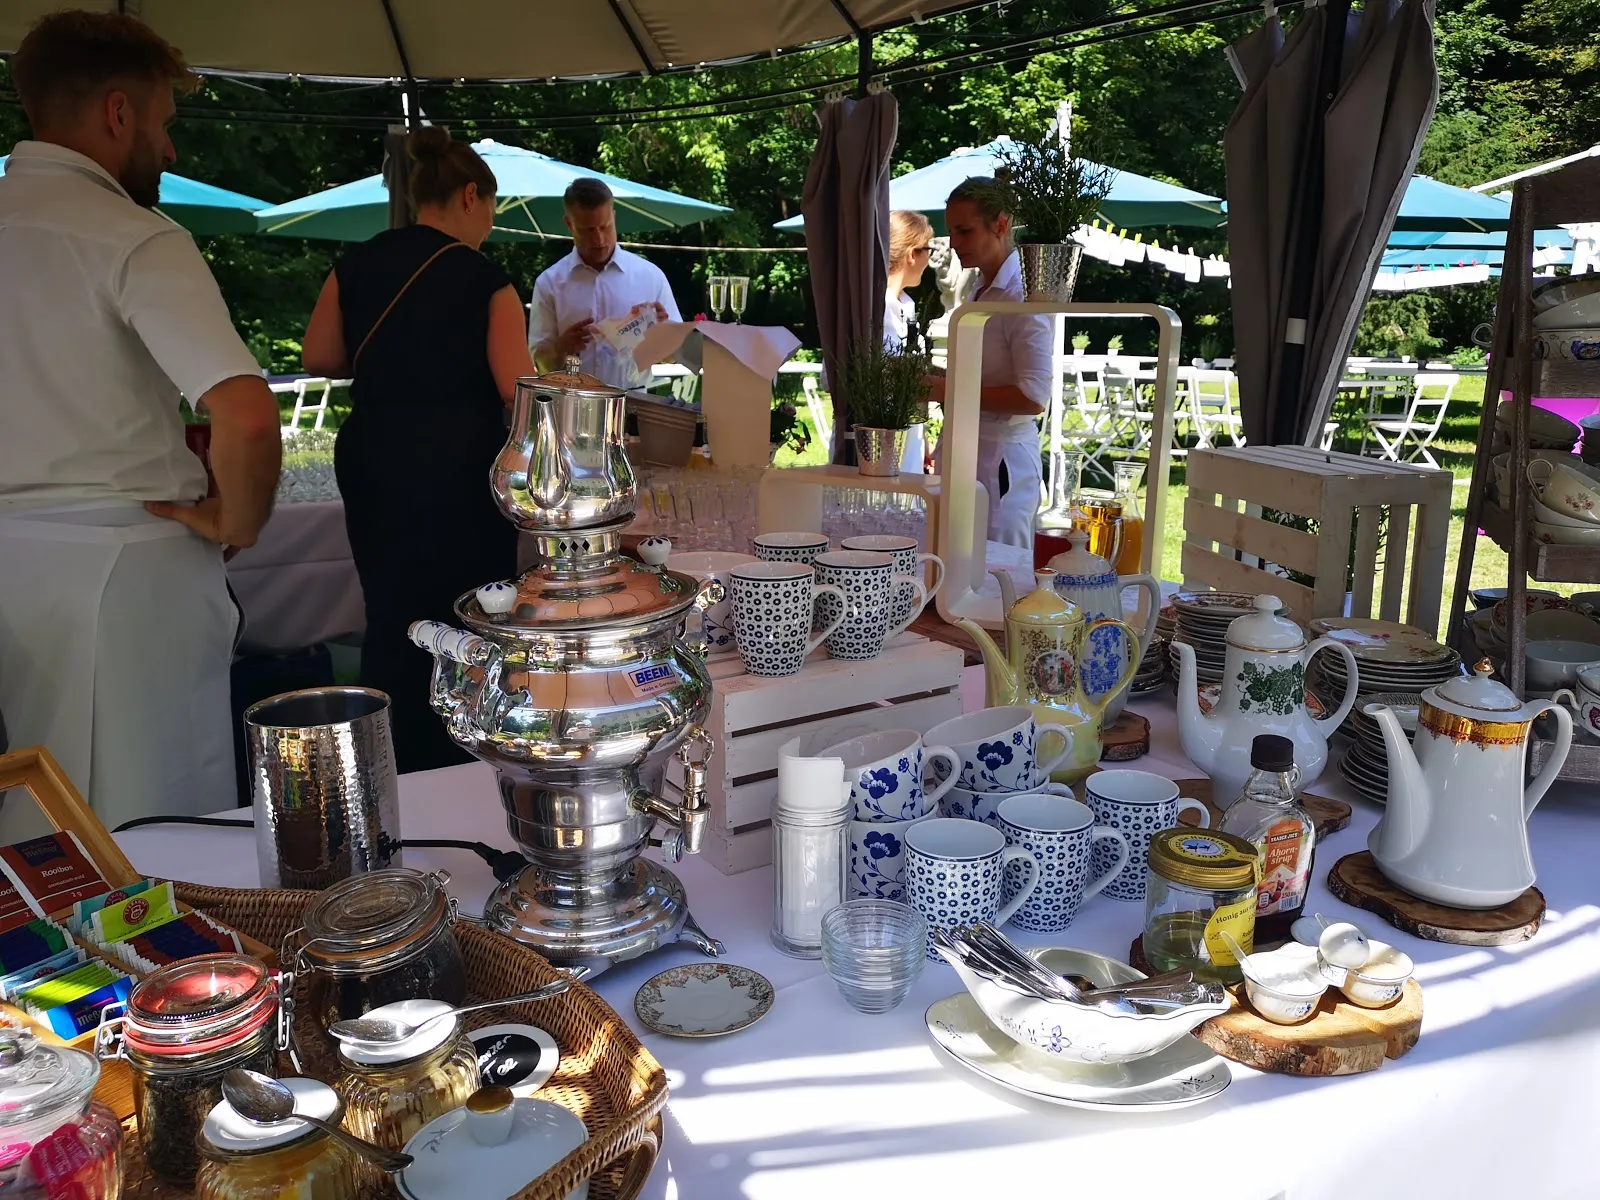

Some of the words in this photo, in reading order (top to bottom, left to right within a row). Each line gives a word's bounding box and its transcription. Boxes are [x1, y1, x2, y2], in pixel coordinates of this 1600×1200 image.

[636, 666, 670, 684] BEEM
[1268, 847, 1298, 858] Ahorn-
[1270, 854, 1293, 866] sirup
[41, 864, 74, 878] Rooibos
[1215, 912, 1239, 924] Honig
[1239, 908, 1249, 916] aus
[76, 1007, 116, 1027] Meßer
[481, 1057, 519, 1084] Tee
